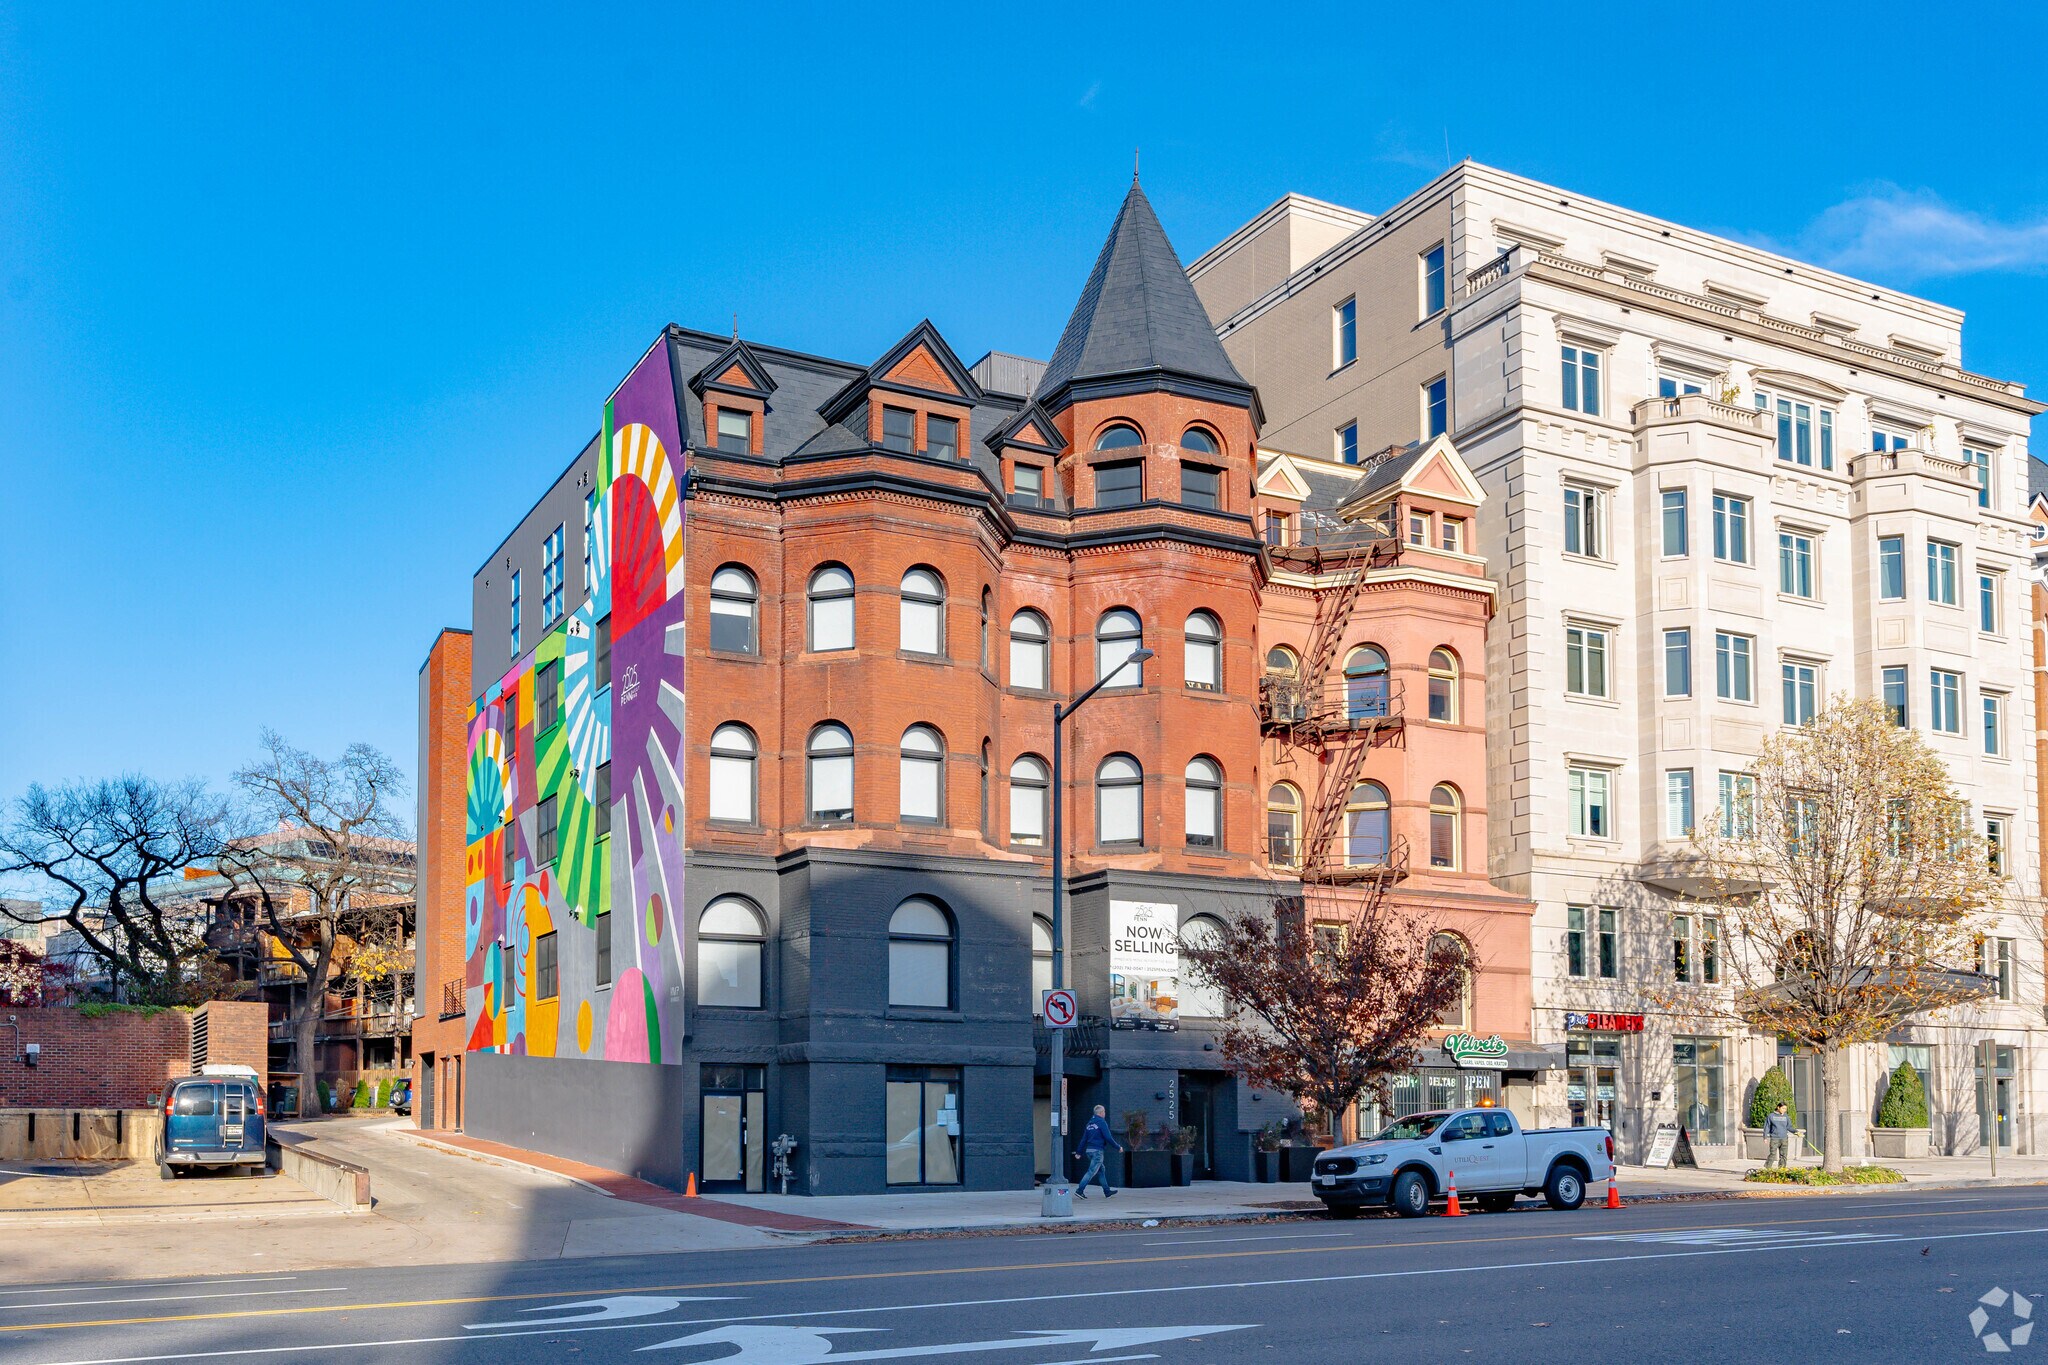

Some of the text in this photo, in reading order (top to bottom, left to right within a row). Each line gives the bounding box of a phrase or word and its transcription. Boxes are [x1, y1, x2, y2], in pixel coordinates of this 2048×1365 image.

[1135, 905, 1154, 917] 2525
[1126, 925, 1163, 940] NOW
[1114, 939, 1175, 955] SELLING
[1587, 1013, 1645, 1031] CLEANERS
[1445, 1033, 1509, 1055] Velvet's
